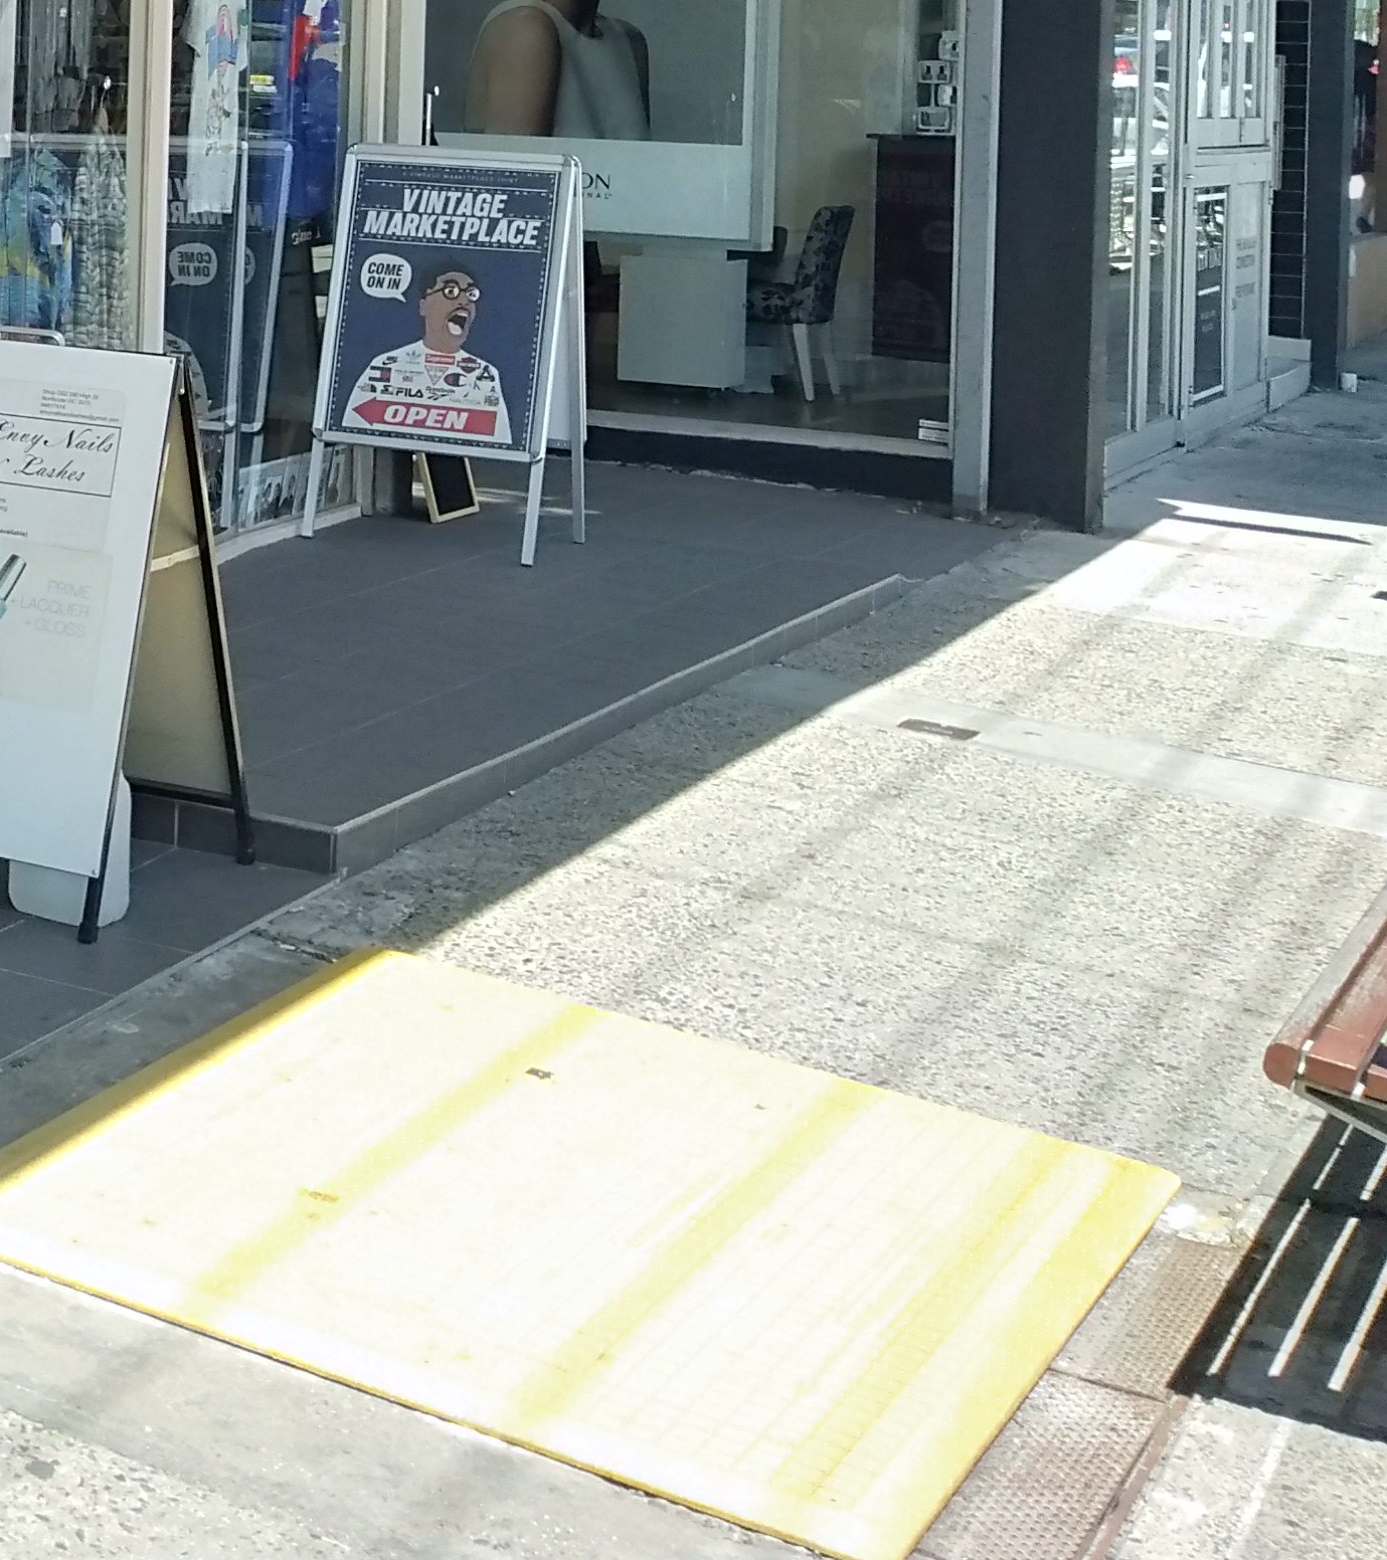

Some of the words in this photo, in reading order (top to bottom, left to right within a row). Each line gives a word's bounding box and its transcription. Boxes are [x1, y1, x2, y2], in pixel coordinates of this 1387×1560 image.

[402, 188, 508, 219] VINTAGE
[363, 210, 541, 246] MARKETPLACE
[367, 262, 405, 277] COME
[367, 276, 385, 289] ON
[387, 277, 401, 290] IN
[396, 387, 424, 398] FILA
[383, 404, 469, 430] OPEN
[43, 428, 115, 453] Nails
[13, 454, 86, 482] Lashes
[48, 580, 93, 599] PRIME
[21, 596, 89, 618] LACQUER
[35, 617, 86, 638] GLOSS
